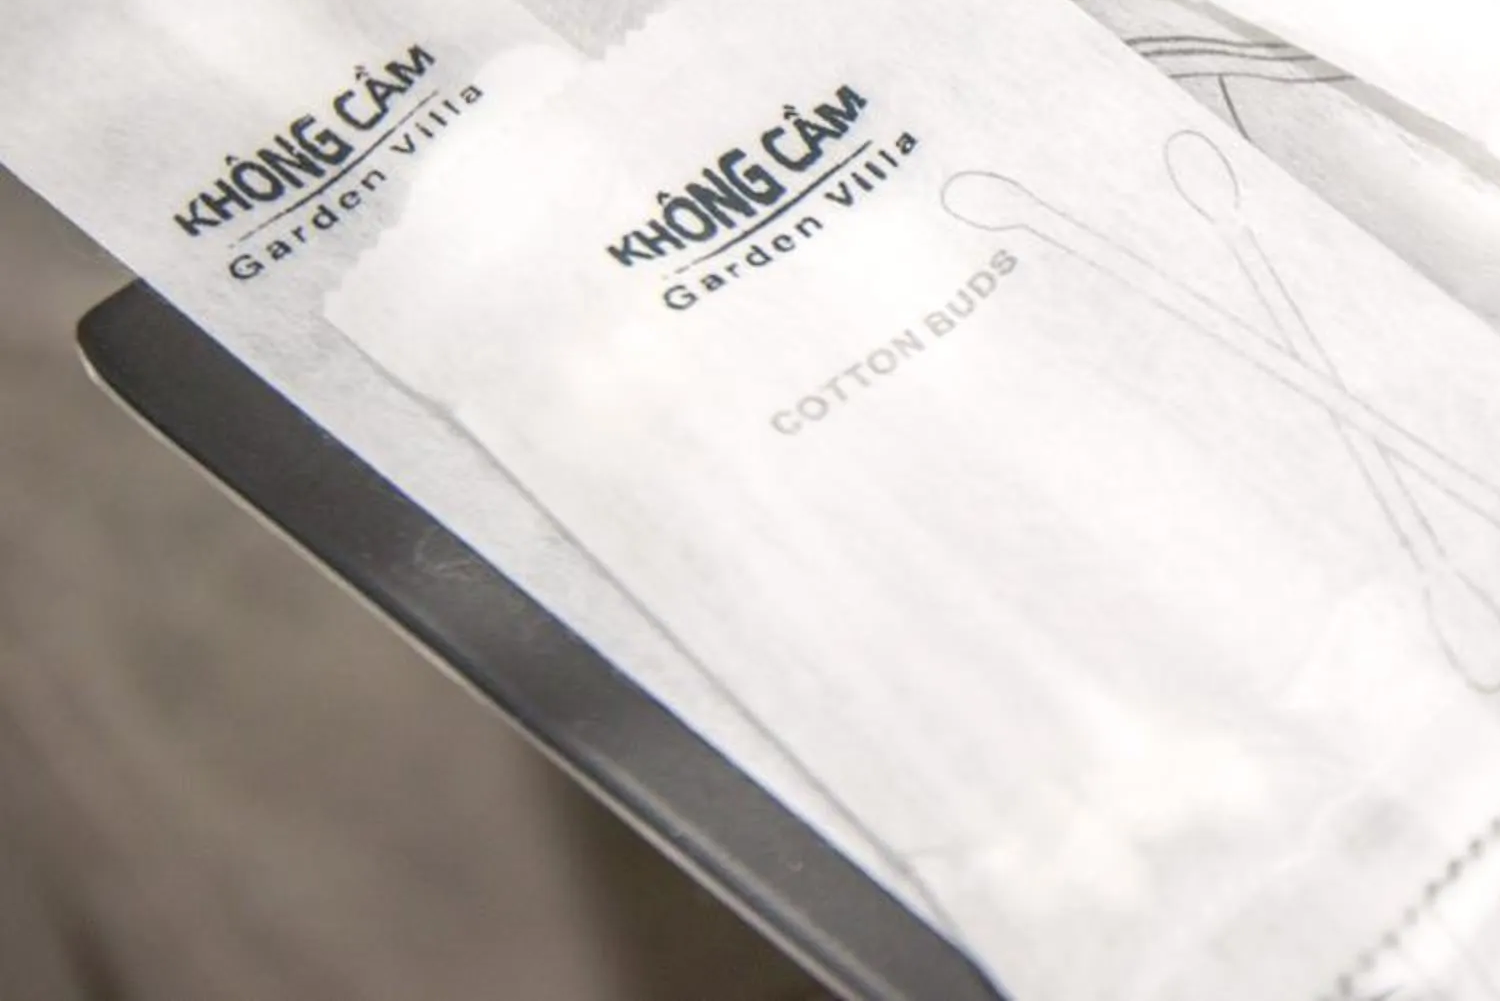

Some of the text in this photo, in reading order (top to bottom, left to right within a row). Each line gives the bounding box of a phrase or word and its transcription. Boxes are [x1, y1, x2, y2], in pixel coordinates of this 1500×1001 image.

[173, 113, 355, 237] KHÔNG
[228, 84, 484, 281] Garden Villa
[606, 147, 787, 267] KHÔNG
[662, 131, 918, 311] Garden Villa
[769, 248, 1020, 437] COTTON BUDS
